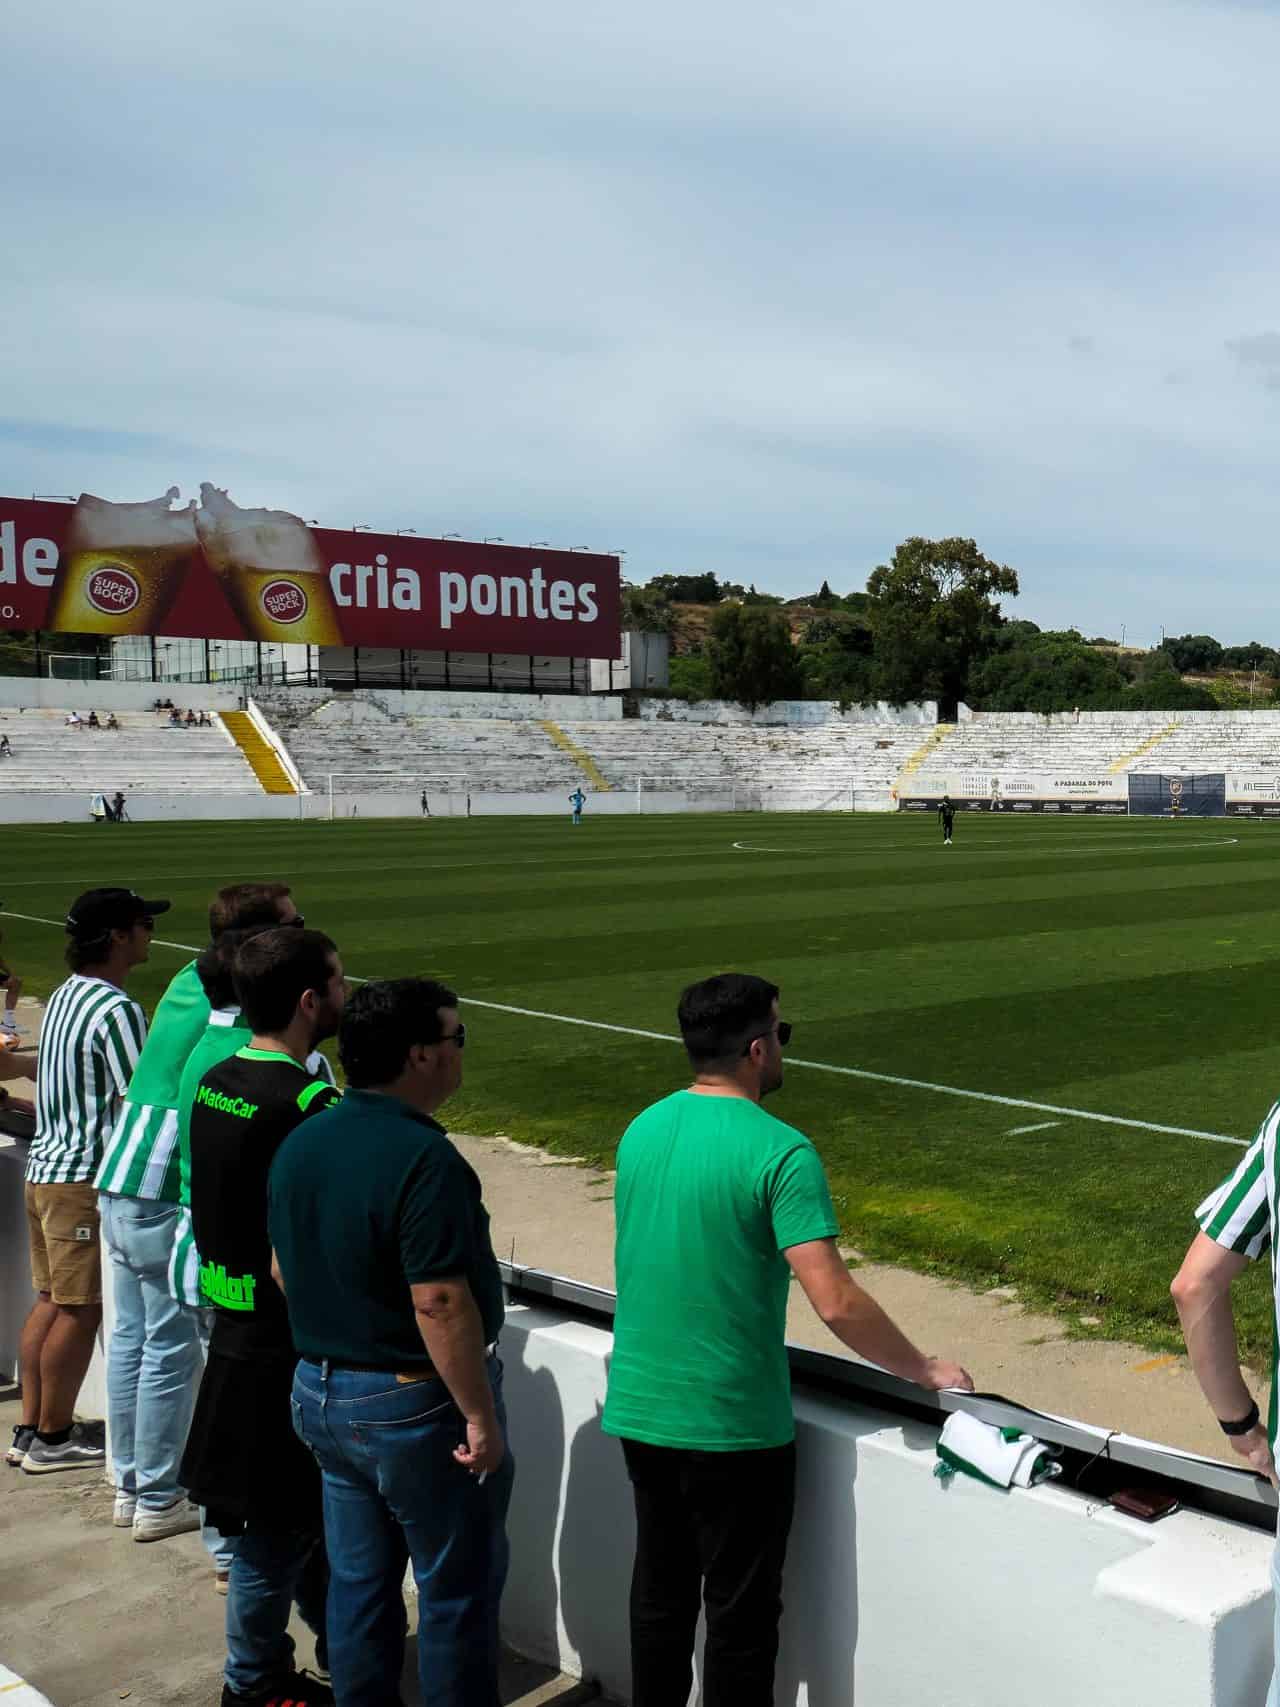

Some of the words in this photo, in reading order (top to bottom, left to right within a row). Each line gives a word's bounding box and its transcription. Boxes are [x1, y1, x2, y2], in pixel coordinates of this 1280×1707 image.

[93, 576, 133, 599] SUPER
[93, 585, 129, 605] BOCK
[265, 590, 299, 606] SUPER
[329, 554, 422, 611] cria
[439, 568, 599, 629] pontes
[270, 598, 301, 614] BOCK
[198, 1086, 258, 1119] MatosCar
